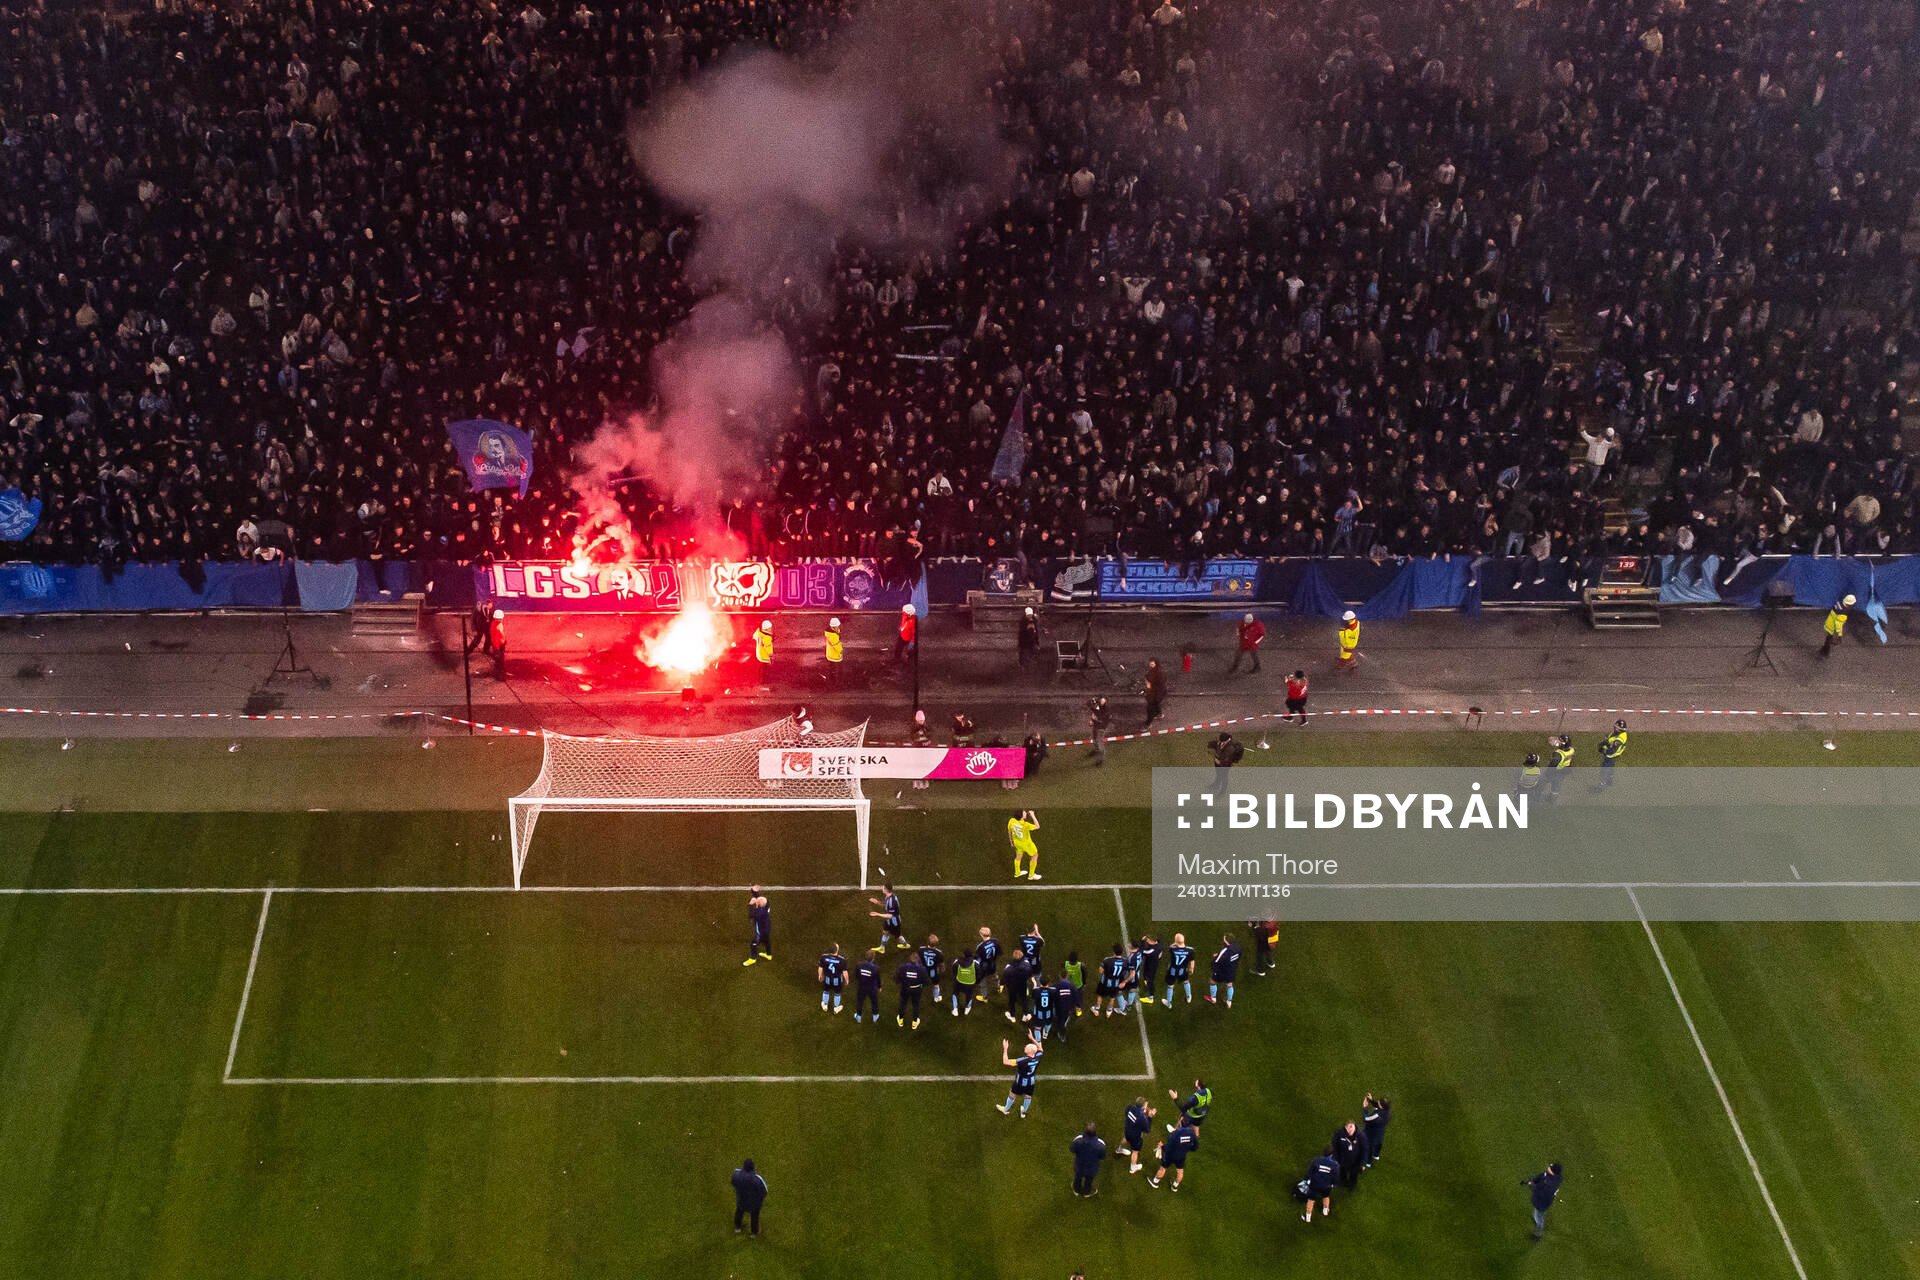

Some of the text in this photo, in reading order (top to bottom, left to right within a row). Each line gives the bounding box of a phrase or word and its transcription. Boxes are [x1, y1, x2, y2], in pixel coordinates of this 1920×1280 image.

[493, 564, 591, 599] LGS
[818, 755, 889, 765] SVENSKA
[818, 766, 853, 776] SPEL
[1026, 943, 1034, 955] 2
[1174, 954, 1187, 966] 17
[828, 963, 836, 974] 4
[1112, 965, 1123, 977] 11
[1040, 996, 1049, 1008] 8
